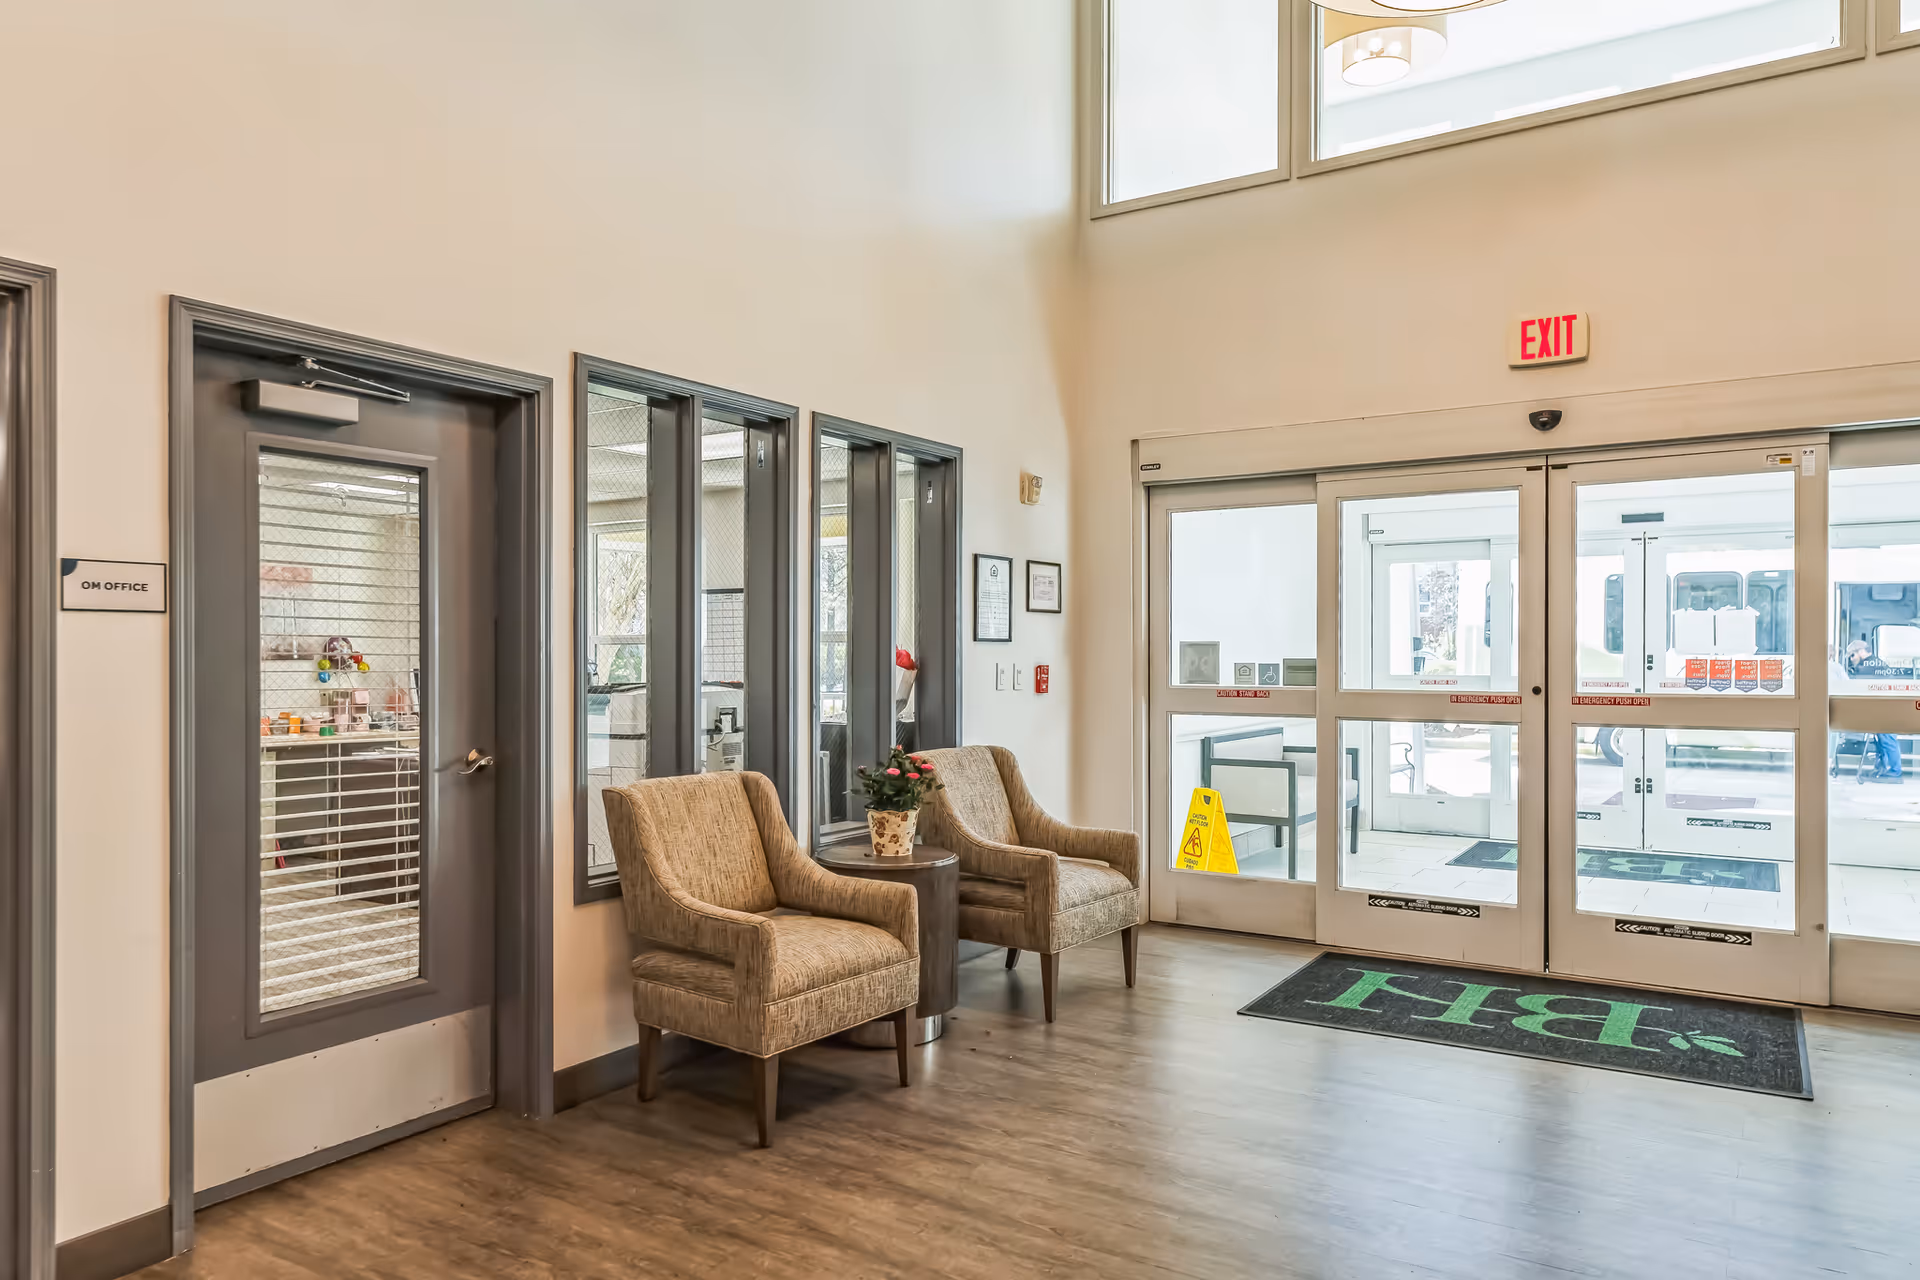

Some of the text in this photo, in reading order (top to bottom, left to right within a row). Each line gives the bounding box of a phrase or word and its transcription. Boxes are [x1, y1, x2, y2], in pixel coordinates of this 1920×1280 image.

[1521, 314, 1577, 360] EXIT
[81, 581, 148, 592] OM OFFICE
[1256, 690, 1269, 698] BACK
[1458, 695, 1490, 703] EMERGENCY
[1192, 813, 1207, 821] CAUTION
